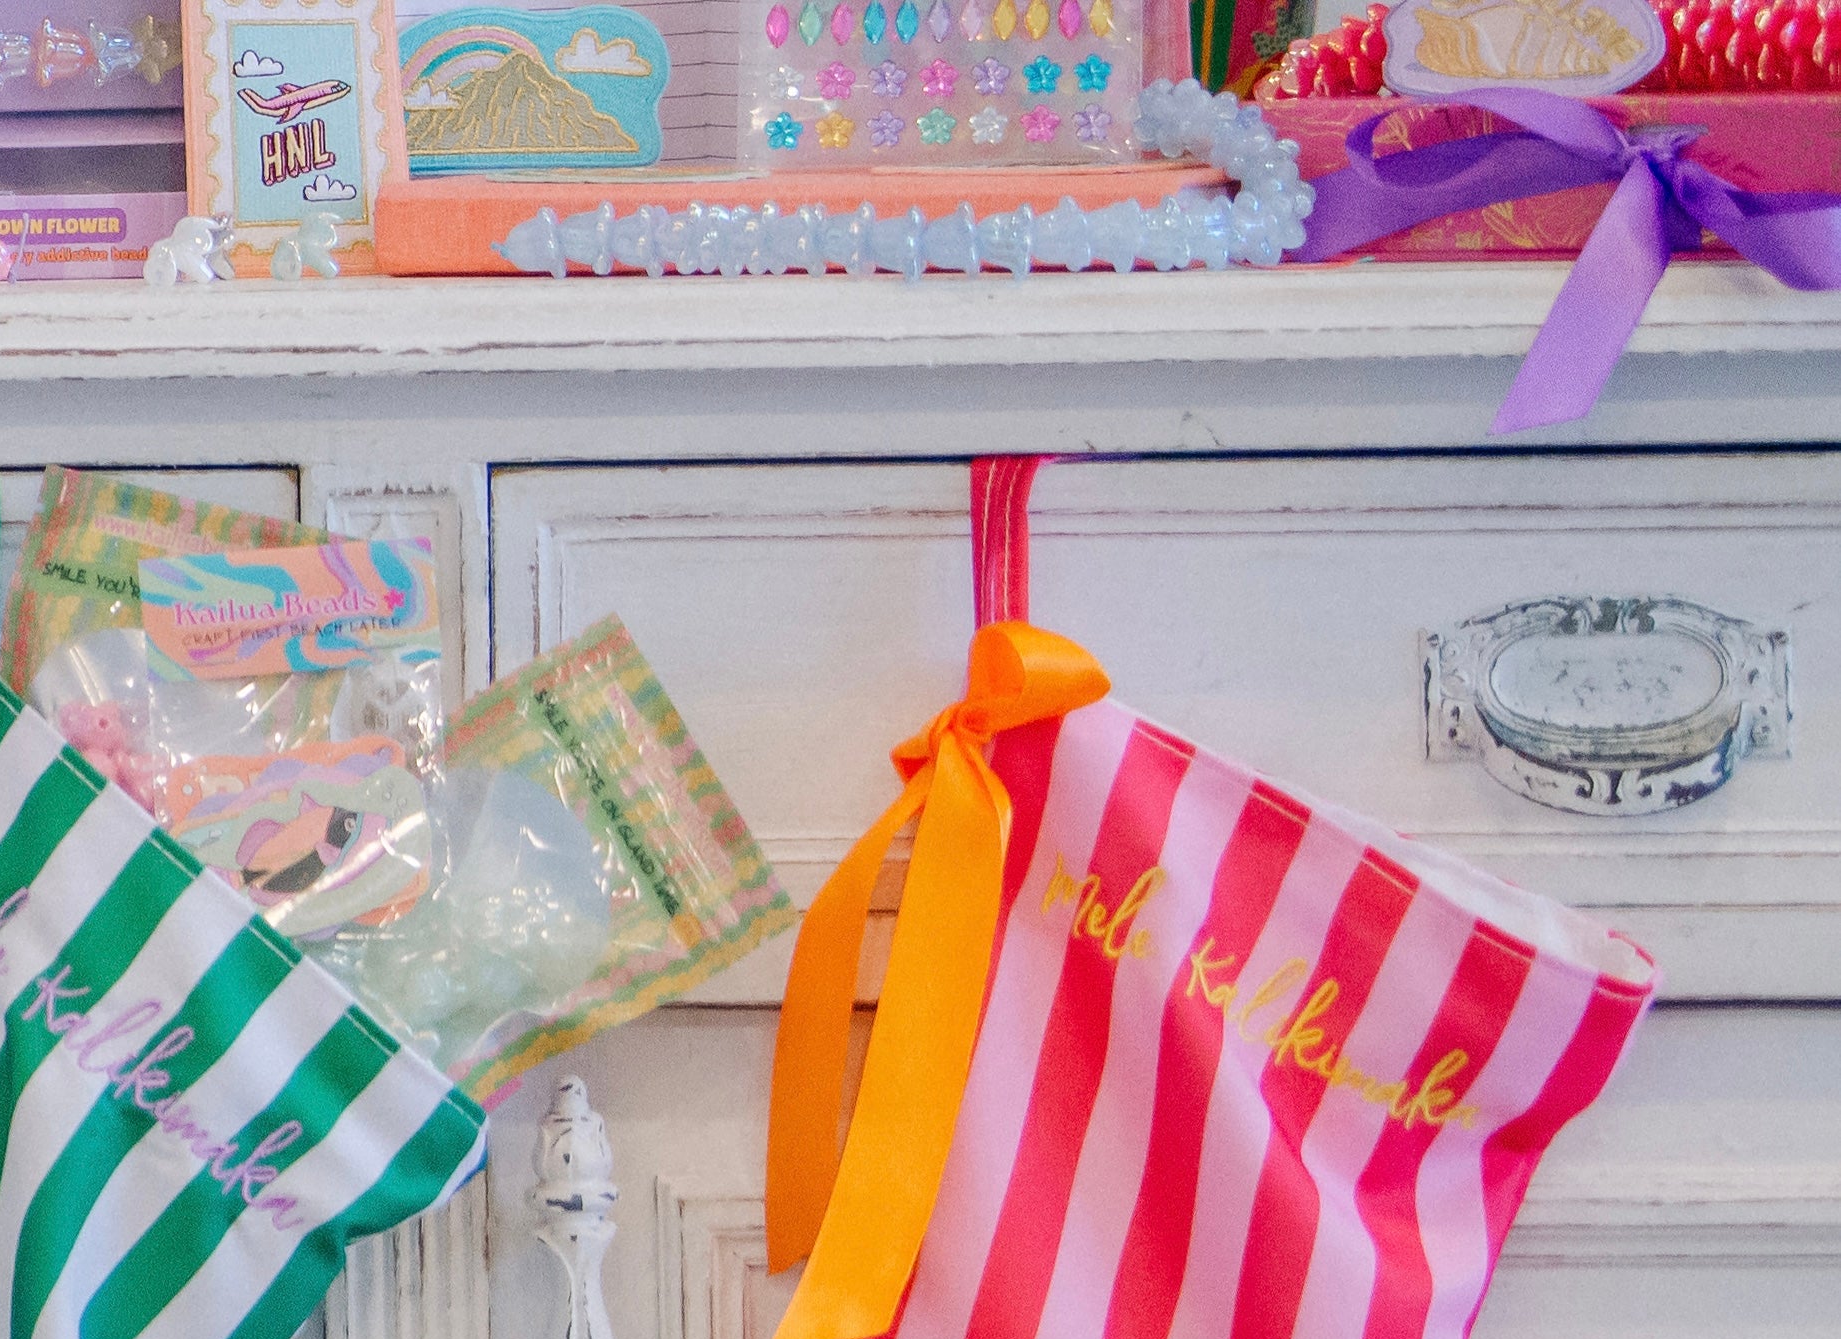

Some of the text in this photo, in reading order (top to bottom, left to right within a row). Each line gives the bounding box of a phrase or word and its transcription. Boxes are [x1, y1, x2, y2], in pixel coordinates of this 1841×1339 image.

[260, 118, 336, 187] HNL
[46, 217, 120, 234] FLOWER
[42, 560, 141, 600] SMILE YOU'R
[174, 589, 379, 626] Kailua Beads
[1040, 852, 1480, 1131] Mele Kalikimaka
[22, 965, 304, 1231] Kalikimaka
